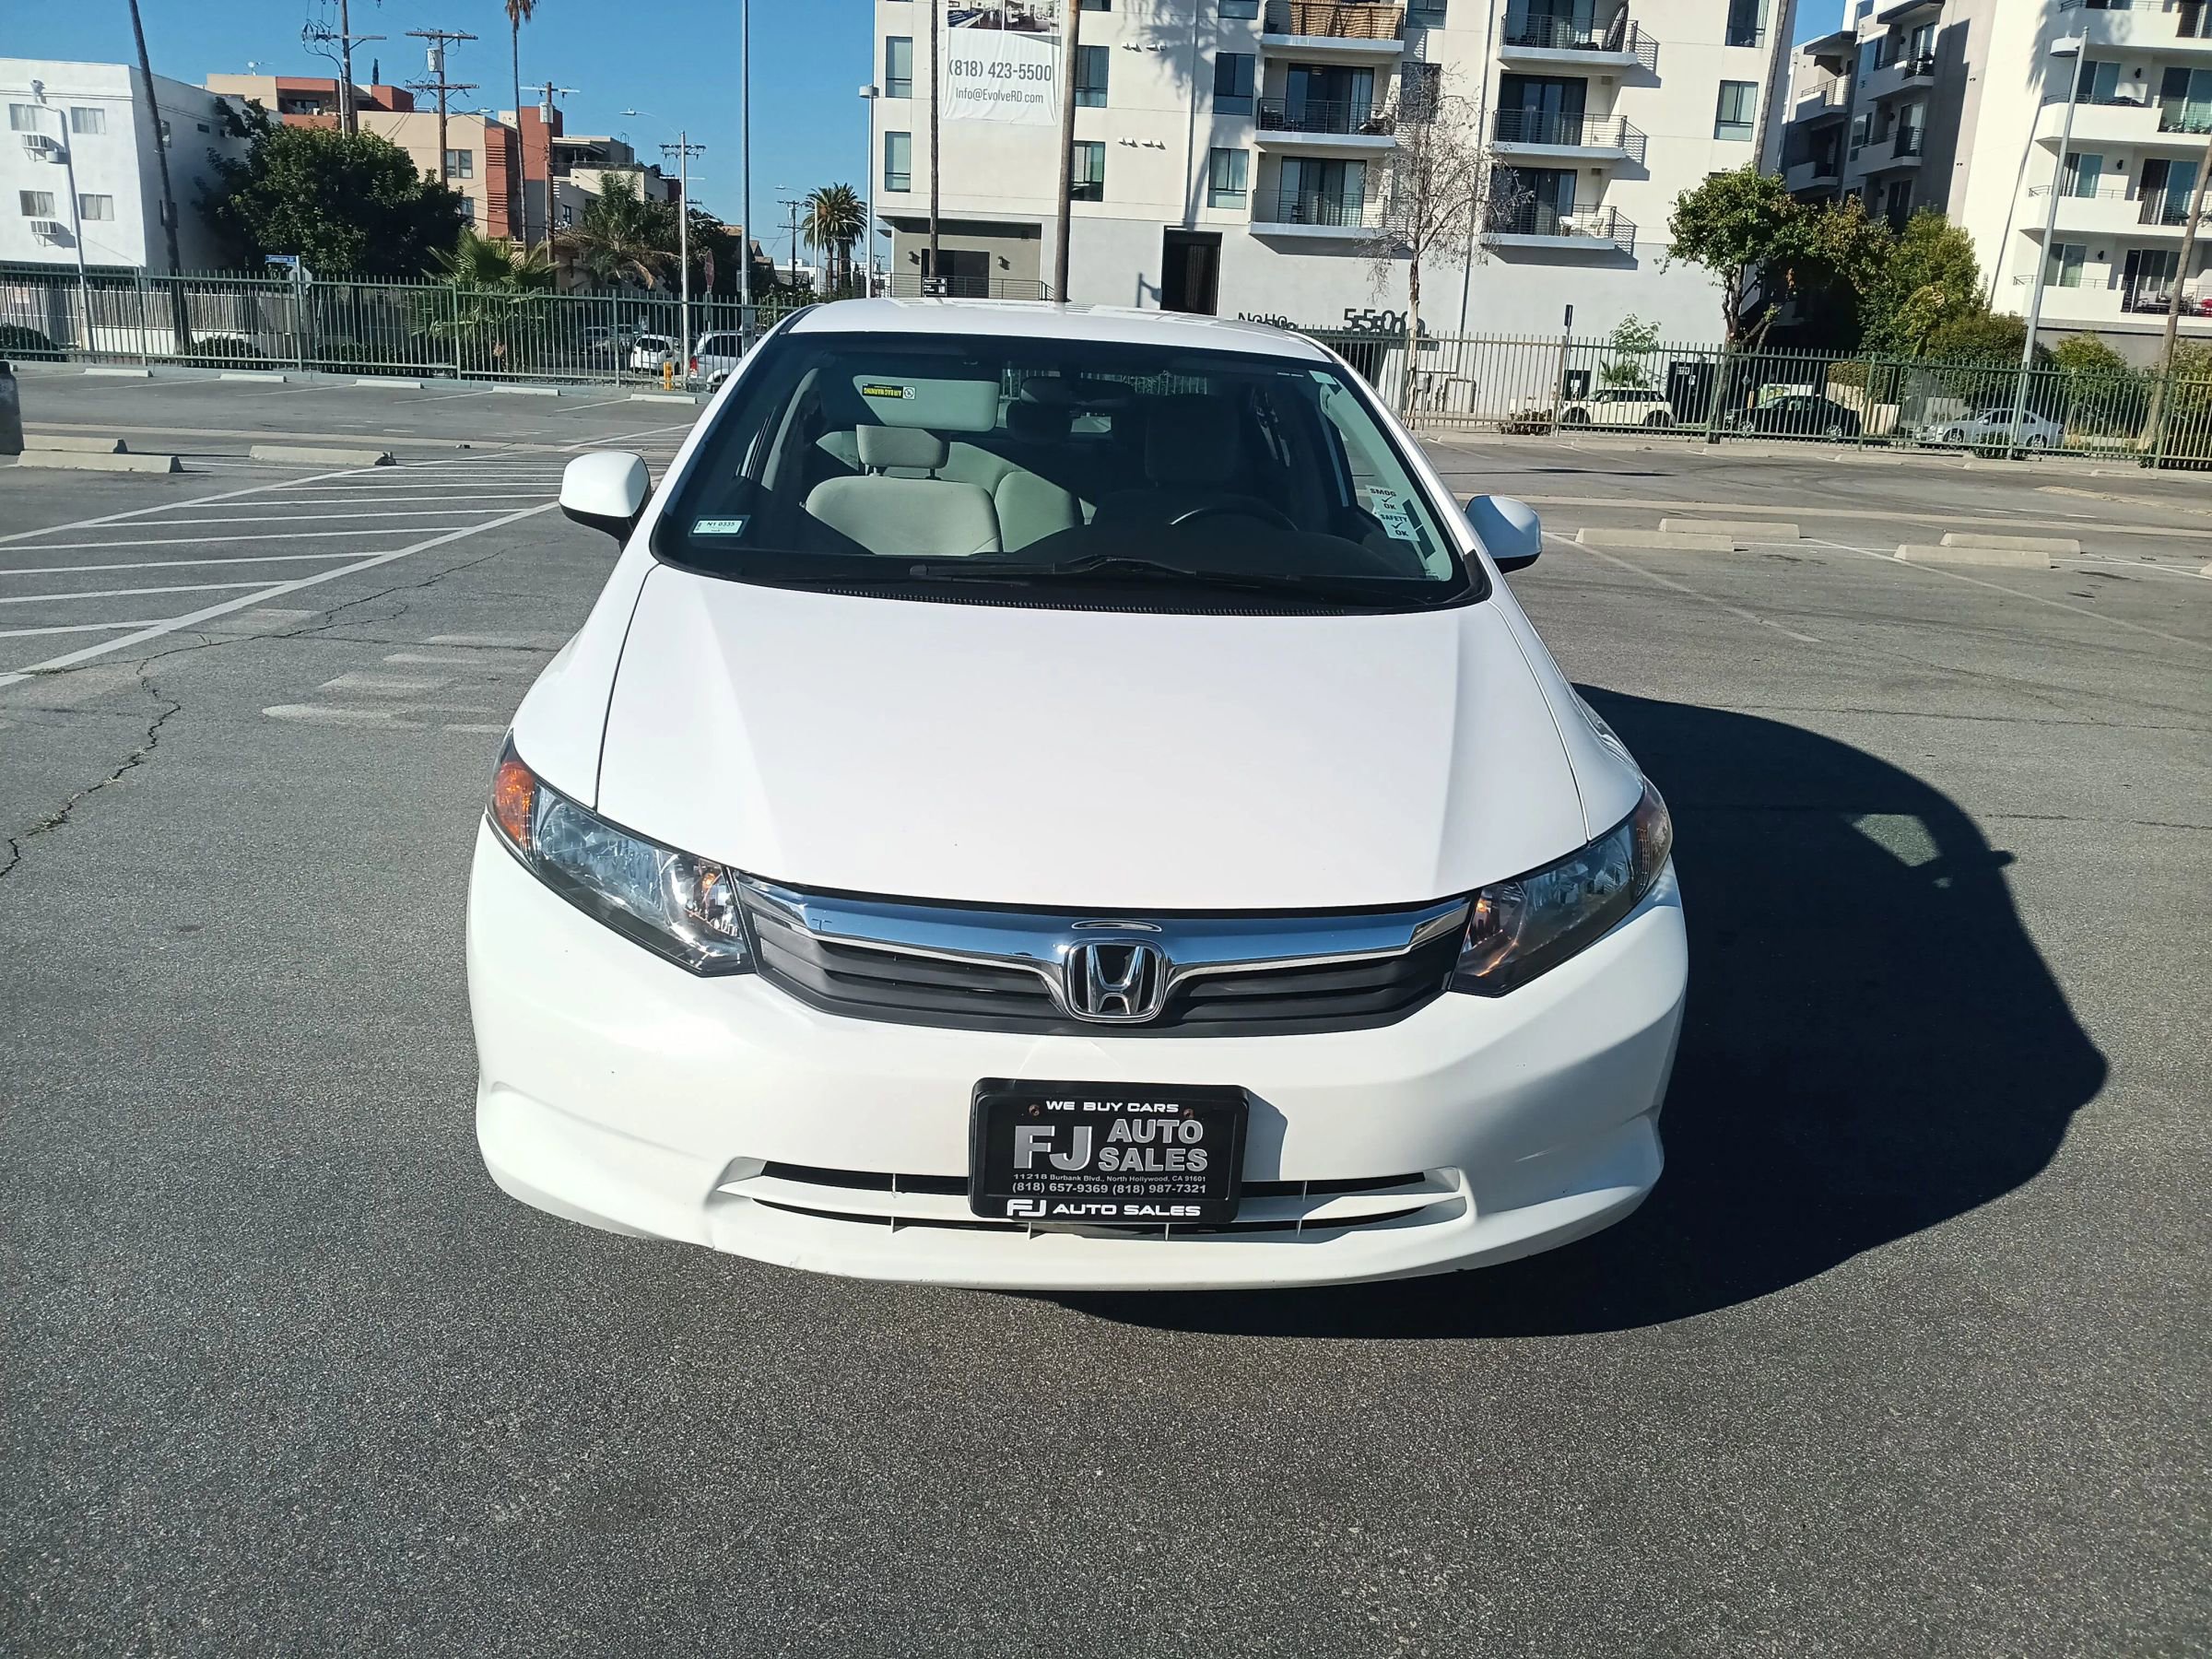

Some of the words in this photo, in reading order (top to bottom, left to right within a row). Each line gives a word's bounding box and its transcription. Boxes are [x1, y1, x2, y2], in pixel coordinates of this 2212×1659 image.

[948, 59, 983, 77] (818)
[988, 62, 1053, 81] 423-5500
[956, 88, 1044, 103] Info@EvolveRD.com
[1370, 488, 1397, 497] SMOG
[1380, 513, 1407, 523] SAFETY
[1045, 1100, 1076, 1111] WE
[1083, 1101, 1123, 1112] BUY
[1127, 1102, 1180, 1113] CARS
[1106, 1118, 1204, 1145] AUTO
[1014, 1125, 1092, 1171] FJ
[1098, 1147, 1208, 1172] SALES
[1012, 1182, 1045, 1194] (818)
[1049, 1182, 1109, 1194] 657-9369
[1112, 1184, 1145, 1195] (818)
[1148, 1183, 1206, 1194] 987-7321
[1006, 1199, 1047, 1217] FJ
[1053, 1204, 1117, 1215] AUTO
[1124, 1205, 1201, 1217] SALES
